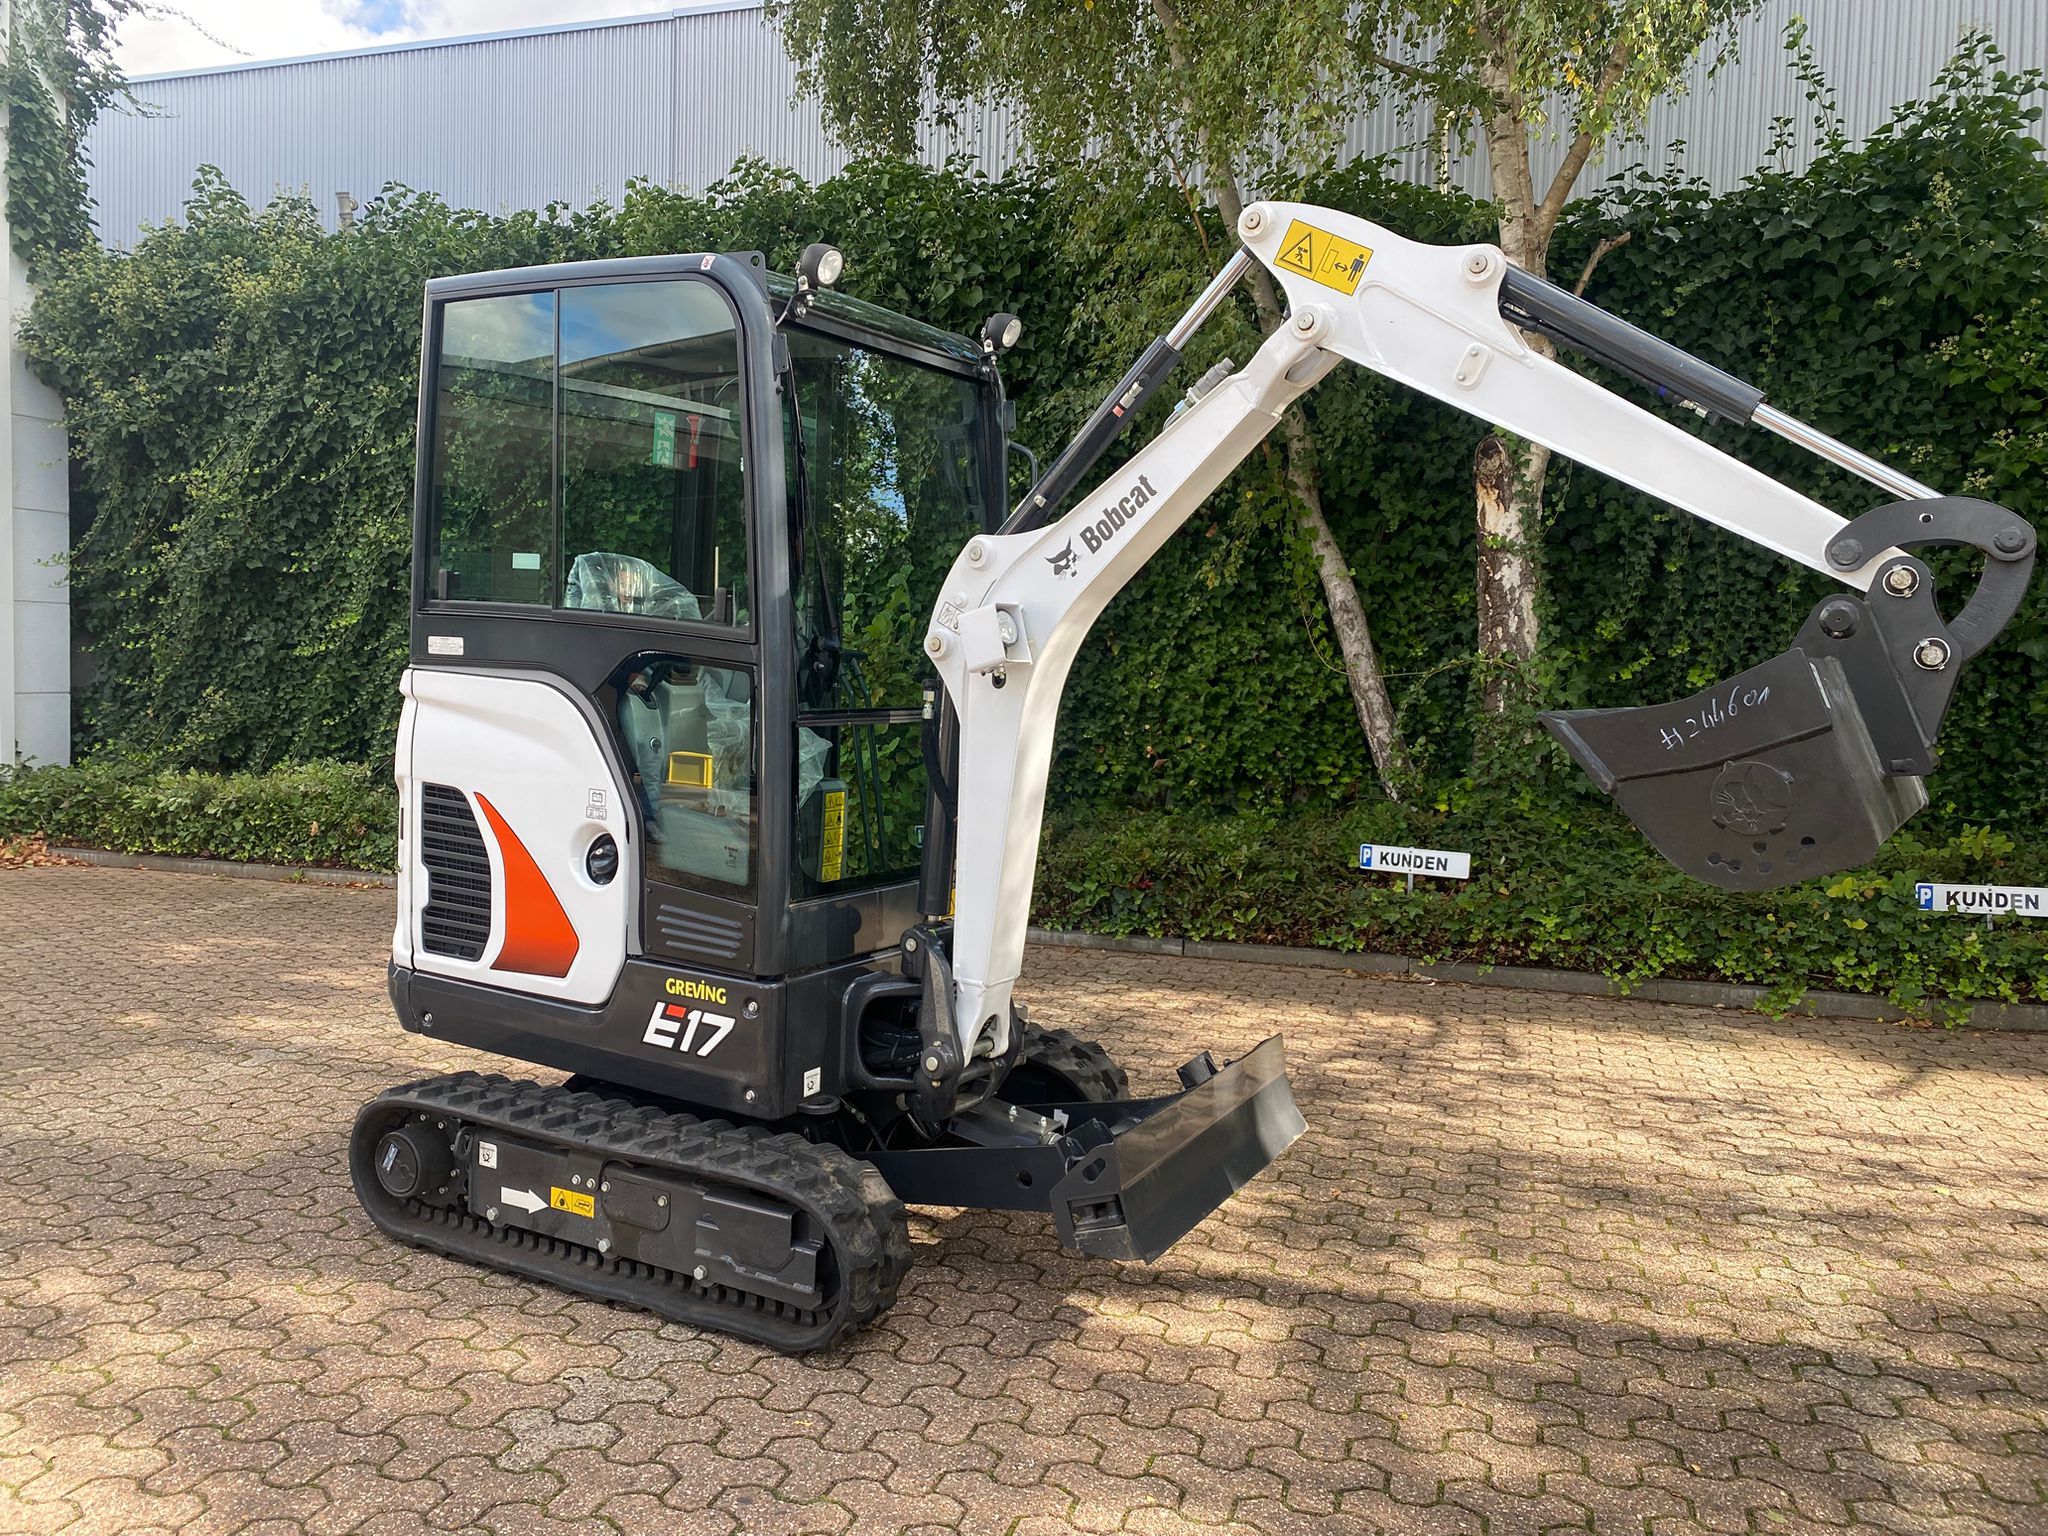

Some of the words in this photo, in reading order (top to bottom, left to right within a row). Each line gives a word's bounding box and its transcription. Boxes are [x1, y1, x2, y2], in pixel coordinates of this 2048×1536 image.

[1079, 474, 1158, 554] Bobcat
[1362, 848, 1371, 864] P
[1380, 851, 1448, 872] KUNDEN
[1920, 887, 1932, 905] P
[1945, 890, 2040, 910] KUNDEN
[642, 1001, 736, 1057] E17
